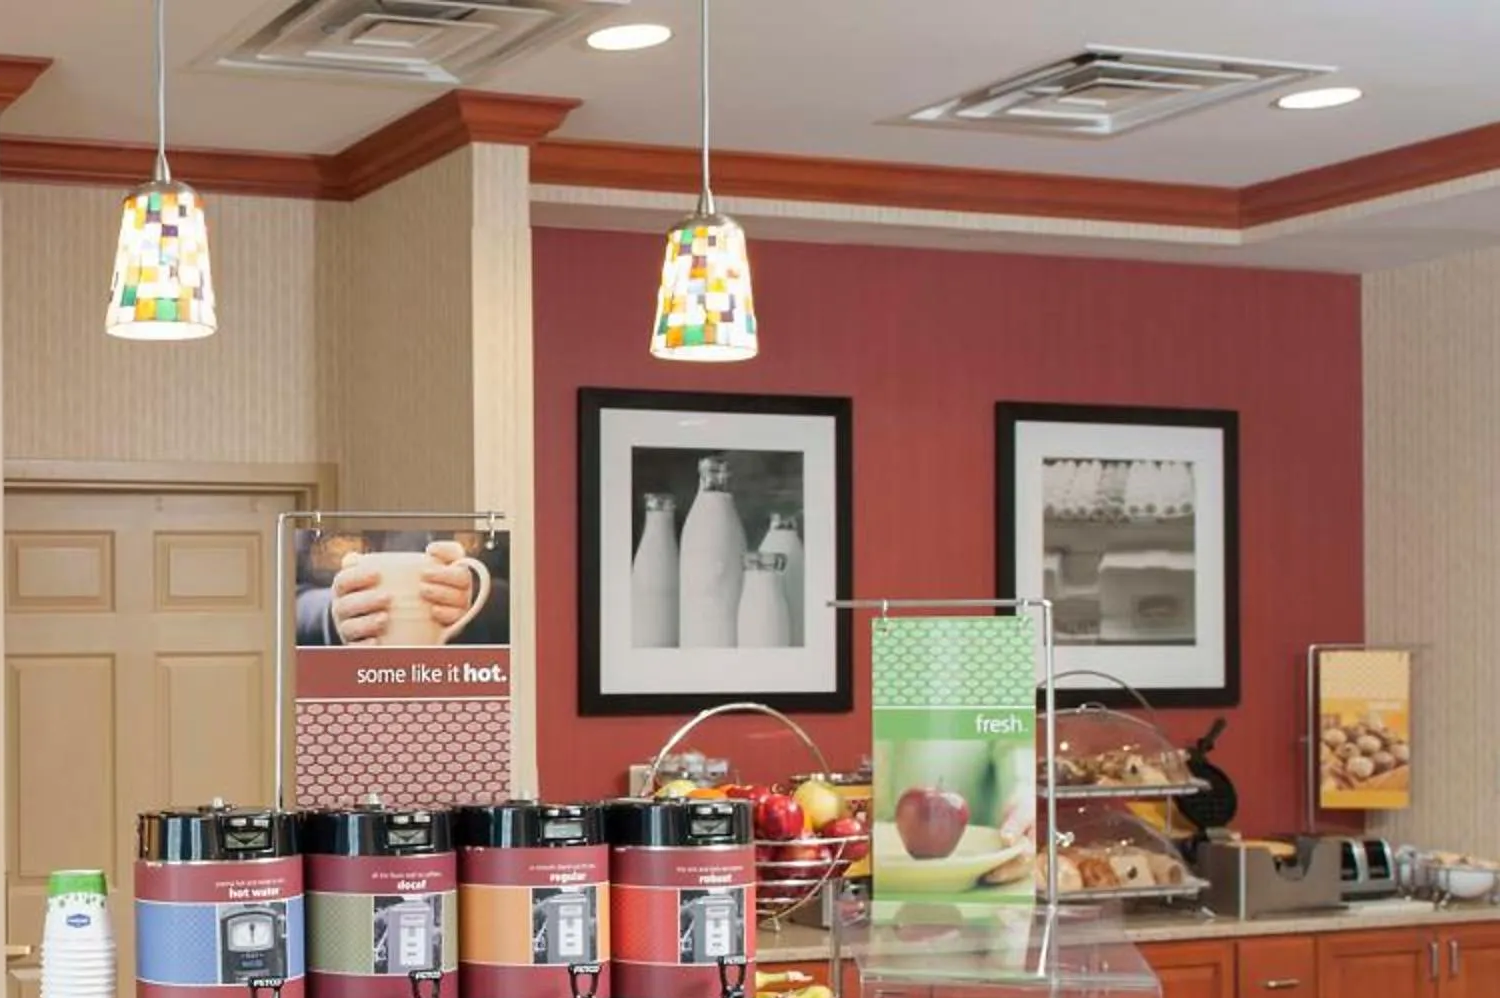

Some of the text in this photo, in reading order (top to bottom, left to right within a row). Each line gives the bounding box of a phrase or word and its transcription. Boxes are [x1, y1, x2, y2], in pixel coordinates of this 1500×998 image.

[357, 663, 508, 683] some like it hot.
[975, 713, 1029, 733] fresh.
[549, 870, 588, 883] regular
[397, 879, 428, 891] decaf
[229, 886, 280, 899] hot water
